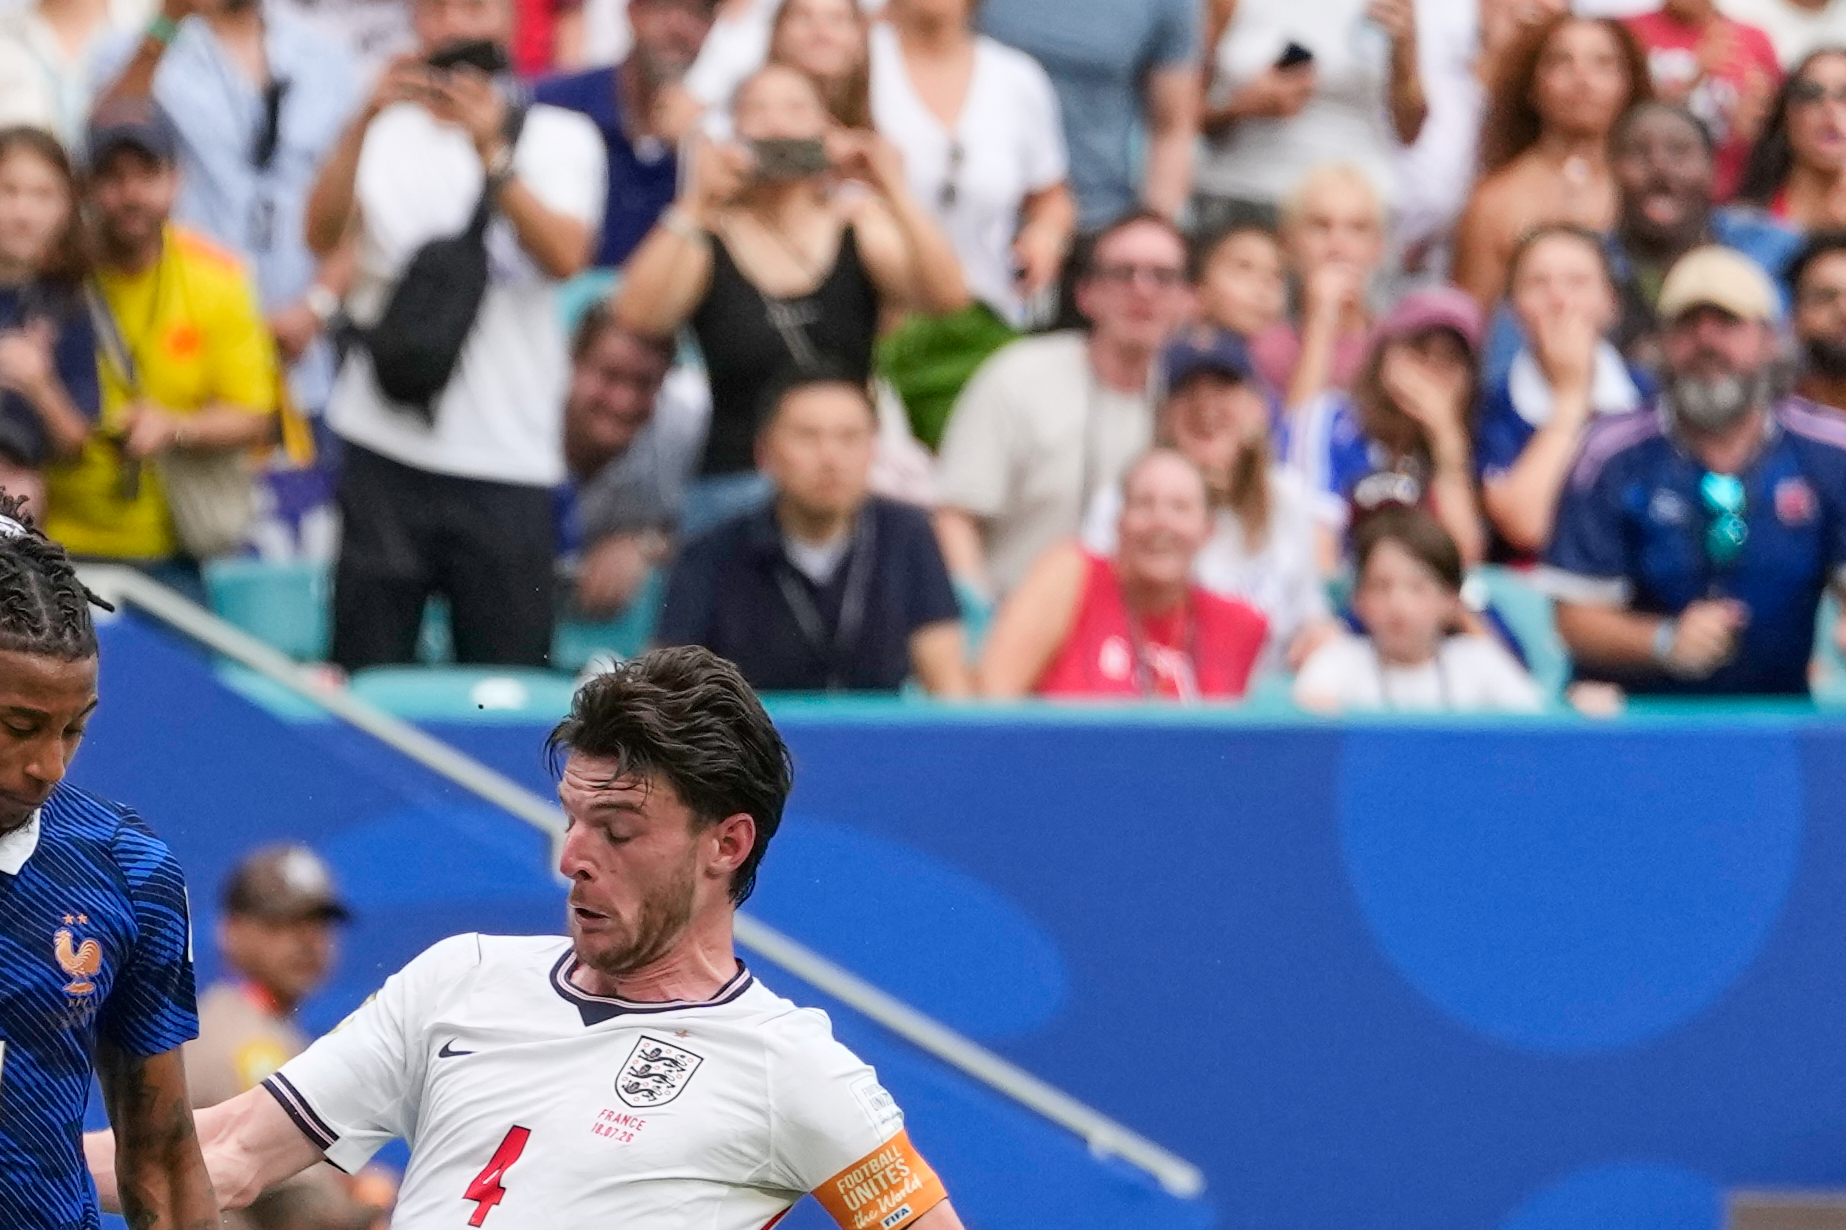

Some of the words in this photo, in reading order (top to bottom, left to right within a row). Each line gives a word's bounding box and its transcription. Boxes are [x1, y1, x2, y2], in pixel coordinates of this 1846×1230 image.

[591, 1122, 634, 1143] 18.07.26
[597, 1109, 646, 1131] FRANCE
[462, 1124, 532, 1228] 4
[836, 1144, 902, 1194] FOOTBALL
[842, 1158, 911, 1211] UNITES
[852, 1210, 879, 1230] the
[876, 1172, 924, 1213] World
[883, 1208, 910, 1227] FIFA
